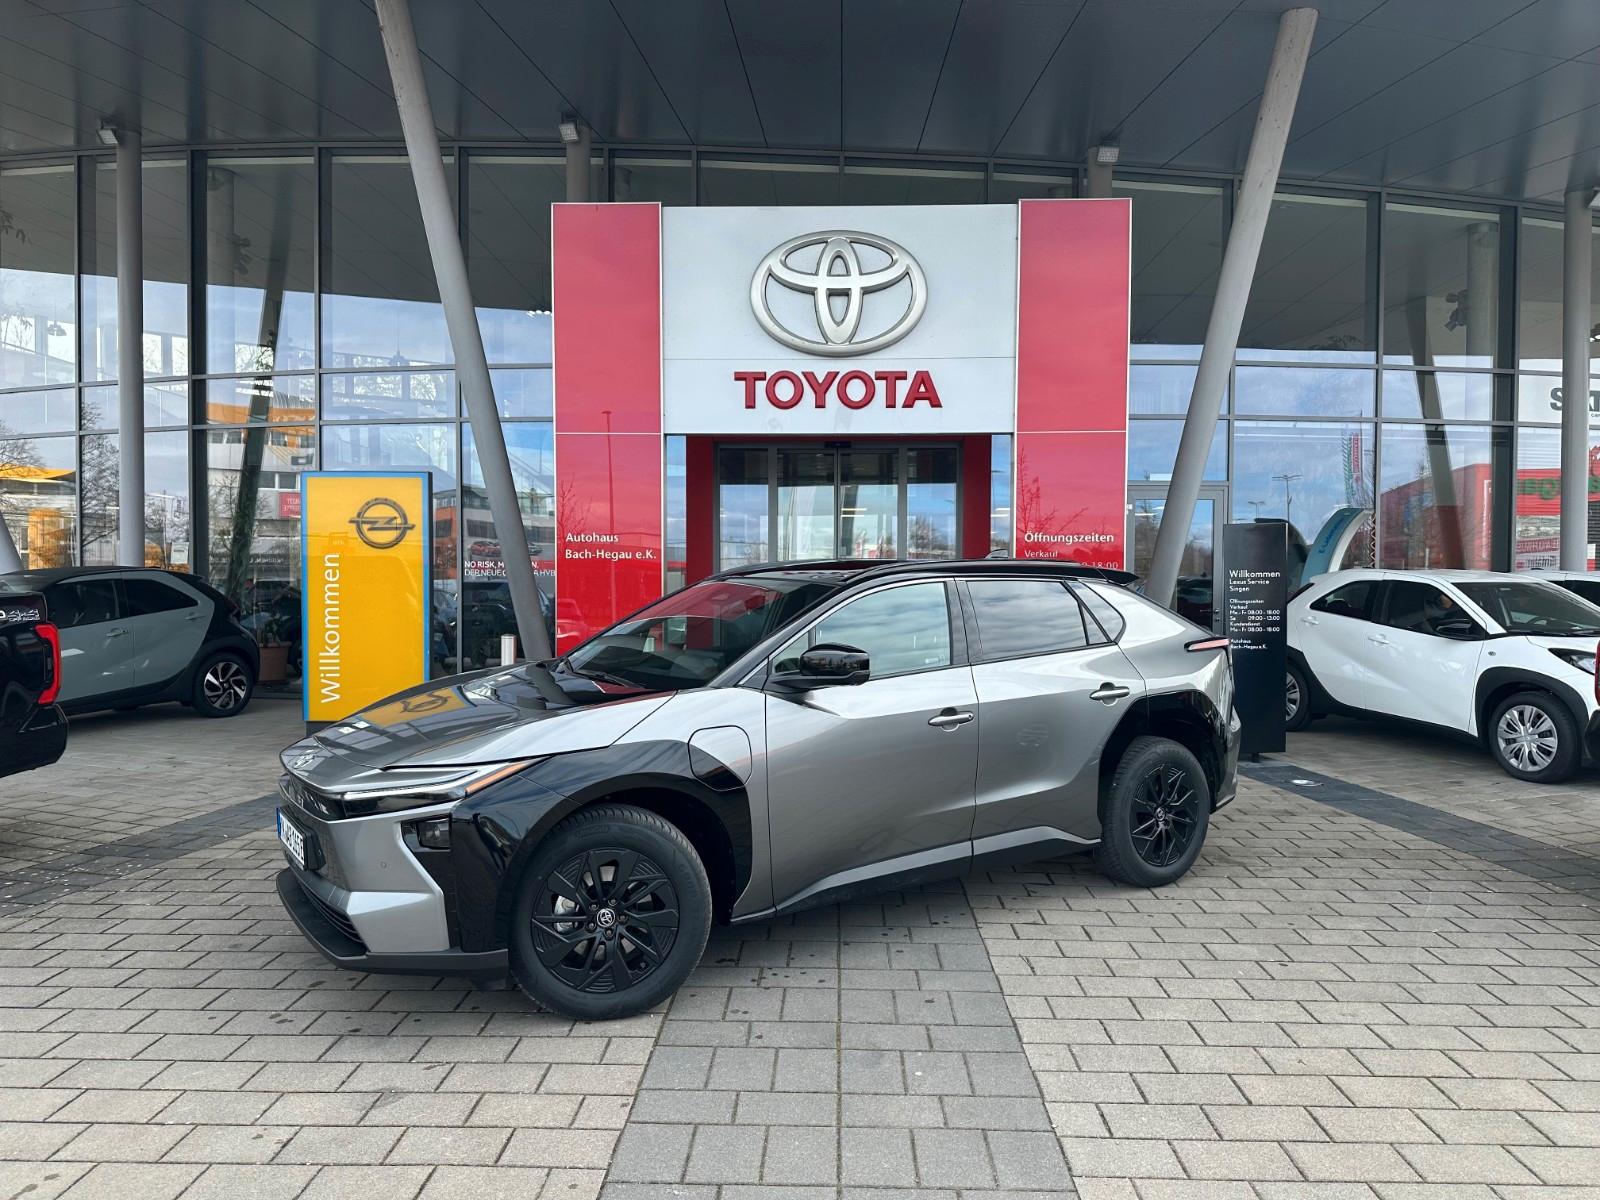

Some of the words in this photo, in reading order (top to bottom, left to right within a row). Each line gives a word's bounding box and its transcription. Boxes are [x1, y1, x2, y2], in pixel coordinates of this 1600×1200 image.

[734, 370, 942, 409] TOYOTA
[565, 533, 618, 542] Autohaus
[1025, 532, 1114, 544] Öffnungszeiten
[565, 549, 632, 561] Bach-Hegau
[636, 550, 656, 558] e.K.
[320, 552, 340, 704] Willkommen
